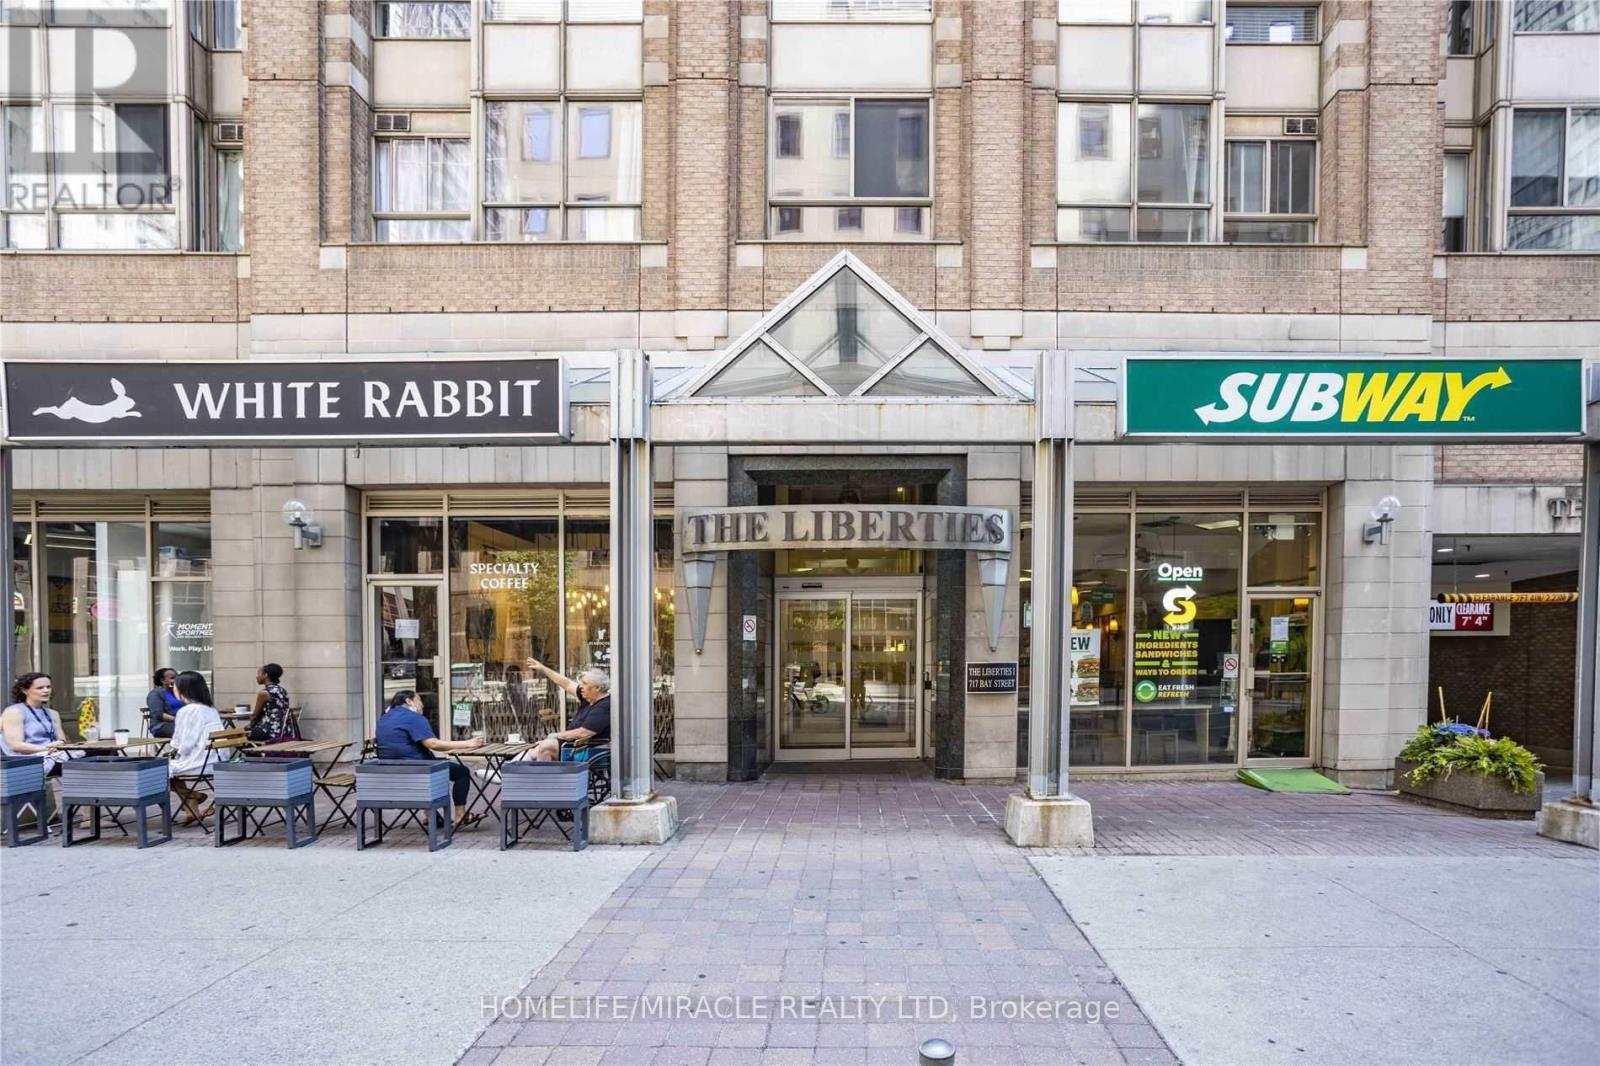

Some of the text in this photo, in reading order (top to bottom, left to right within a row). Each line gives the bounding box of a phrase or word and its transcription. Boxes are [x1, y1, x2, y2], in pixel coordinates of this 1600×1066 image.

[173, 380, 541, 419] WHITE RABBIT
[1194, 367, 1512, 426] SUBWAY
[688, 509, 1005, 544] THE LIBERTIES
[470, 562, 539, 574] SPECIALTY
[1158, 562, 1203, 582] Open
[480, 577, 529, 589] COFFEE
[1456, 602, 1491, 615] CLEARANCE
[1430, 606, 1453, 624] ONLY
[1153, 630, 1182, 640] NEW
[1135, 641, 1198, 649] INGREDIENTS
[1135, 650, 1198, 658] SANDWICHES
[969, 667, 981, 676] THE
[982, 667, 1012, 676] LIBERTIES
[969, 679, 1016, 688] 717 BAY STREET
